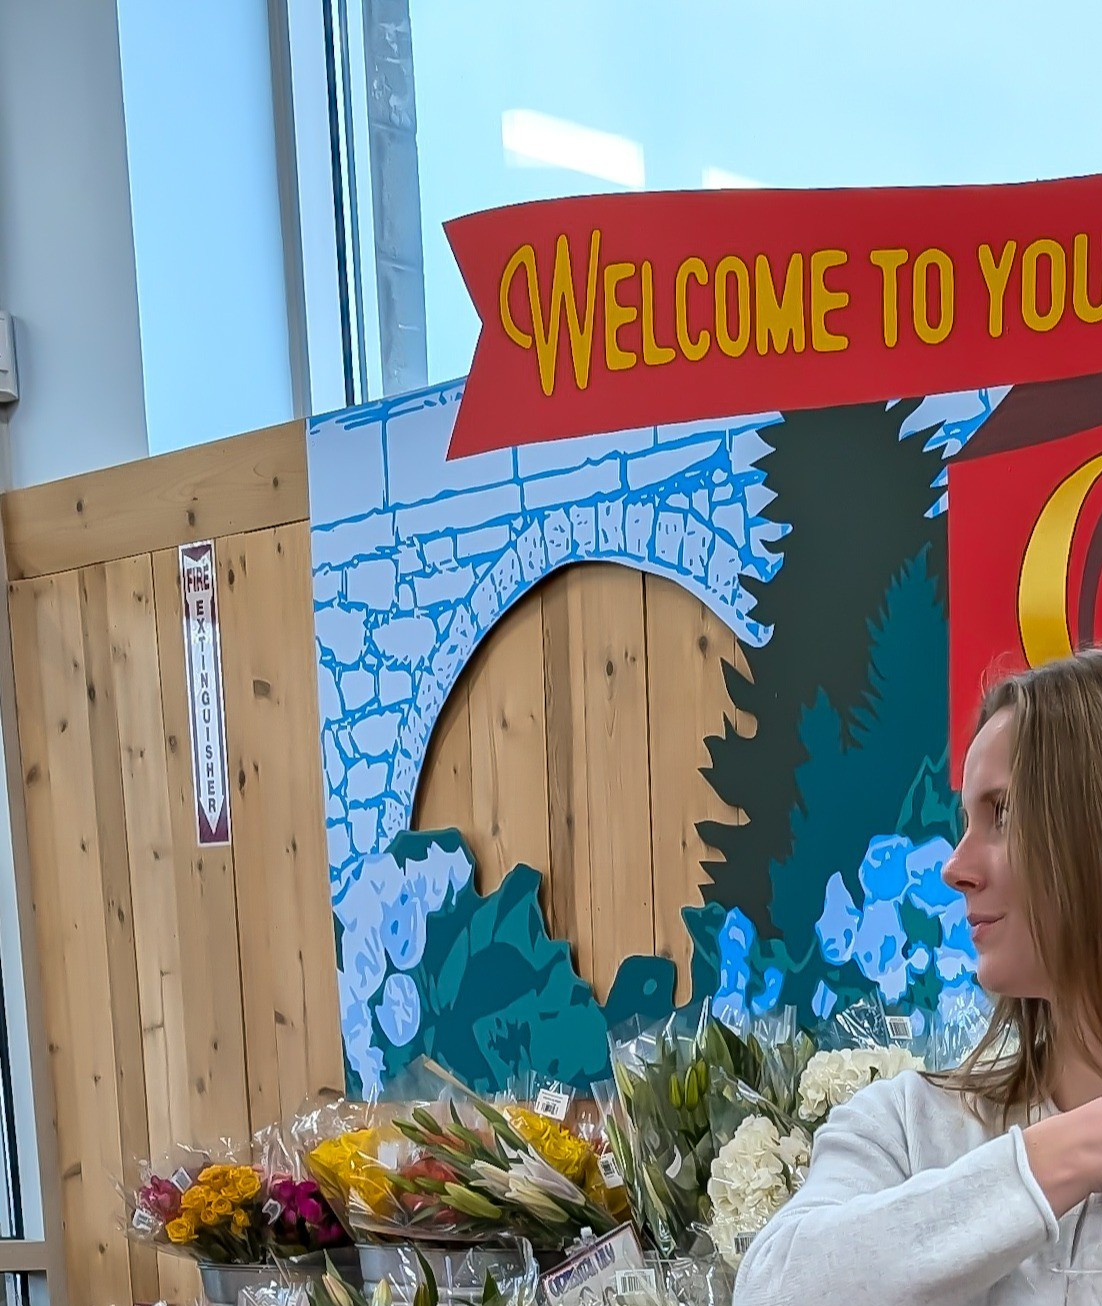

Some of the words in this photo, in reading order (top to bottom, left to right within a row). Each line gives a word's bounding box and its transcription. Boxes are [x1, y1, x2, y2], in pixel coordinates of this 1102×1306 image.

[498, 229, 849, 397] WELCOME
[875, 246, 956, 350] TO
[186, 566, 210, 593] FIRE
[195, 599, 217, 814] EXTINGUISHER
